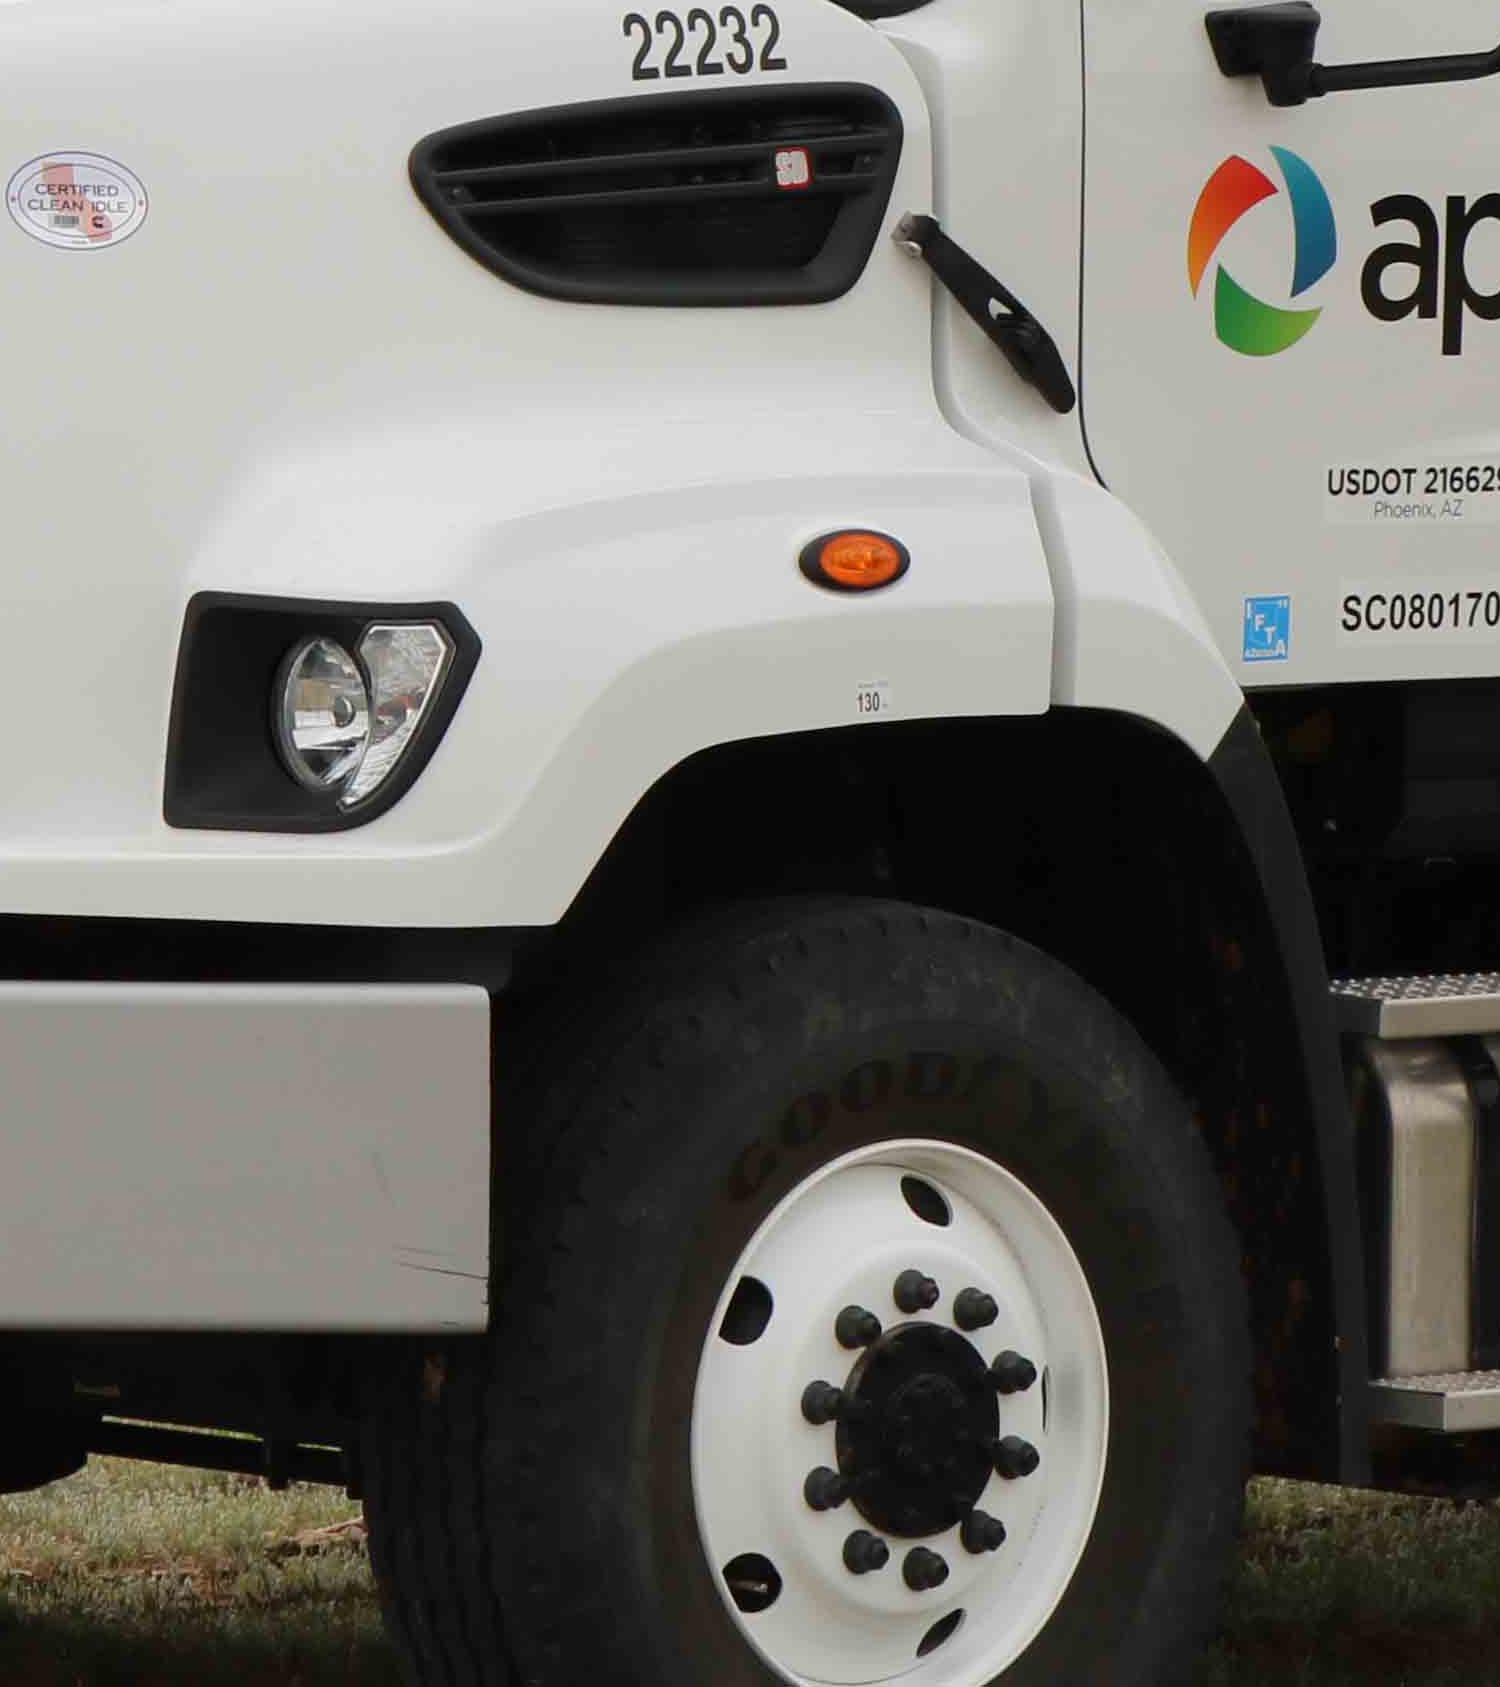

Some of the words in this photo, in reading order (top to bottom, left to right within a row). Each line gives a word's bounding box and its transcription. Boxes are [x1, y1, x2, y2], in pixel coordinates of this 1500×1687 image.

[623, 3, 787, 81] 22232
[34, 183, 120, 198] CERTIFIED
[26, 198, 84, 213] CLEAN
[90, 200, 130, 214] IDLE
[1327, 467, 1417, 496] USDOT
[1374, 500, 1437, 520] Phoenix,
[1441, 498, 1464, 517] AZ
[857, 691, 881, 713] 130
